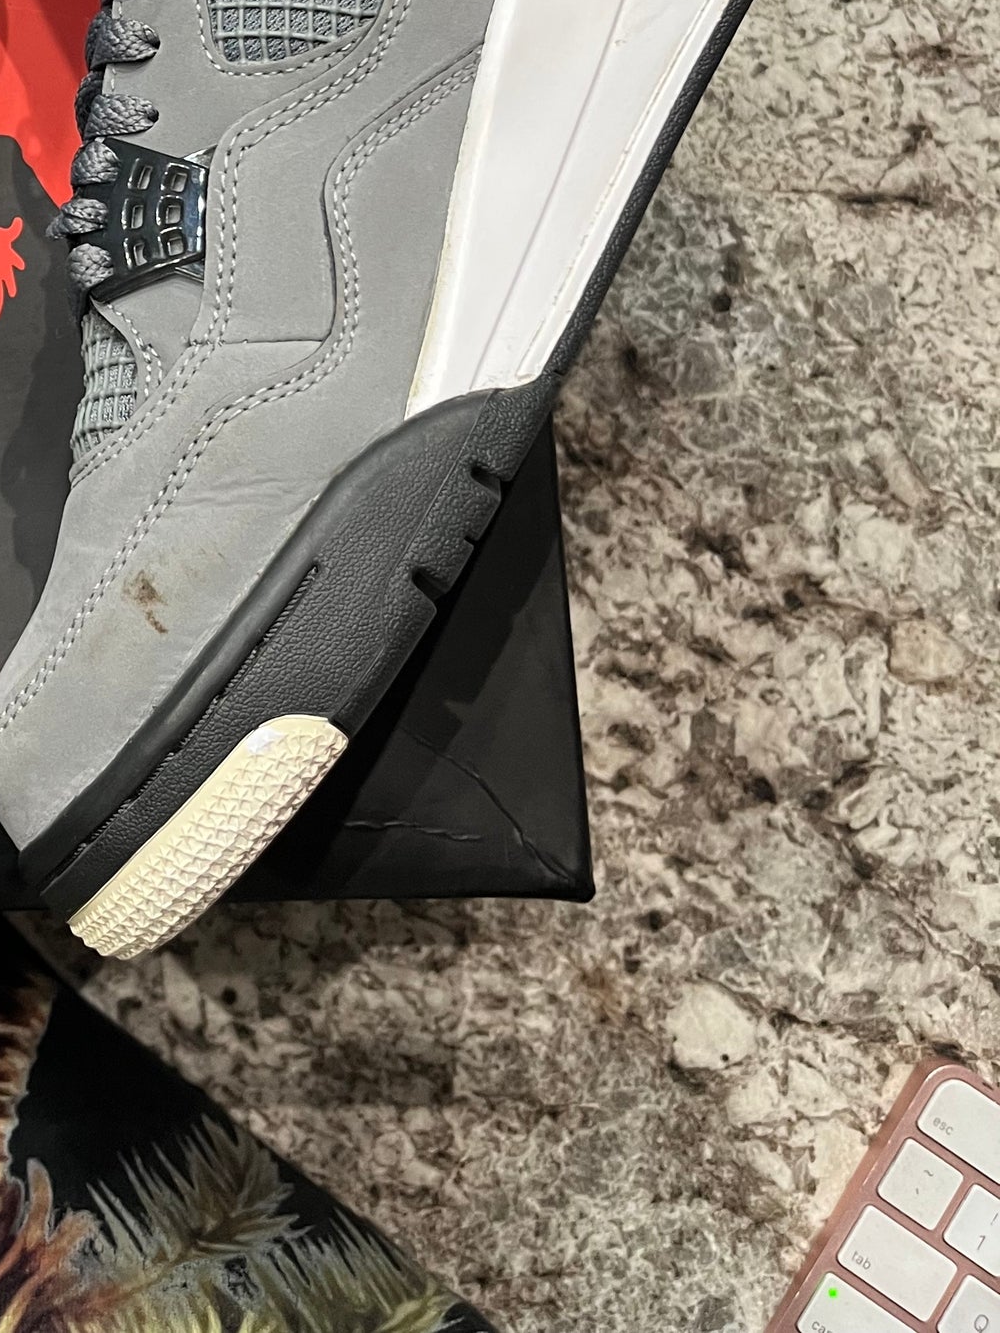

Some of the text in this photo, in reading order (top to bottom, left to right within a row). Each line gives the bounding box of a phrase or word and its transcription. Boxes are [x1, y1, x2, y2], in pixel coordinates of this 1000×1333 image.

[932, 1117, 954, 1136] esc
[977, 1235, 986, 1250] 1
[851, 1251, 871, 1270] tab
[811, 1321, 833, 1333] ca
[974, 1314, 989, 1333] Q
